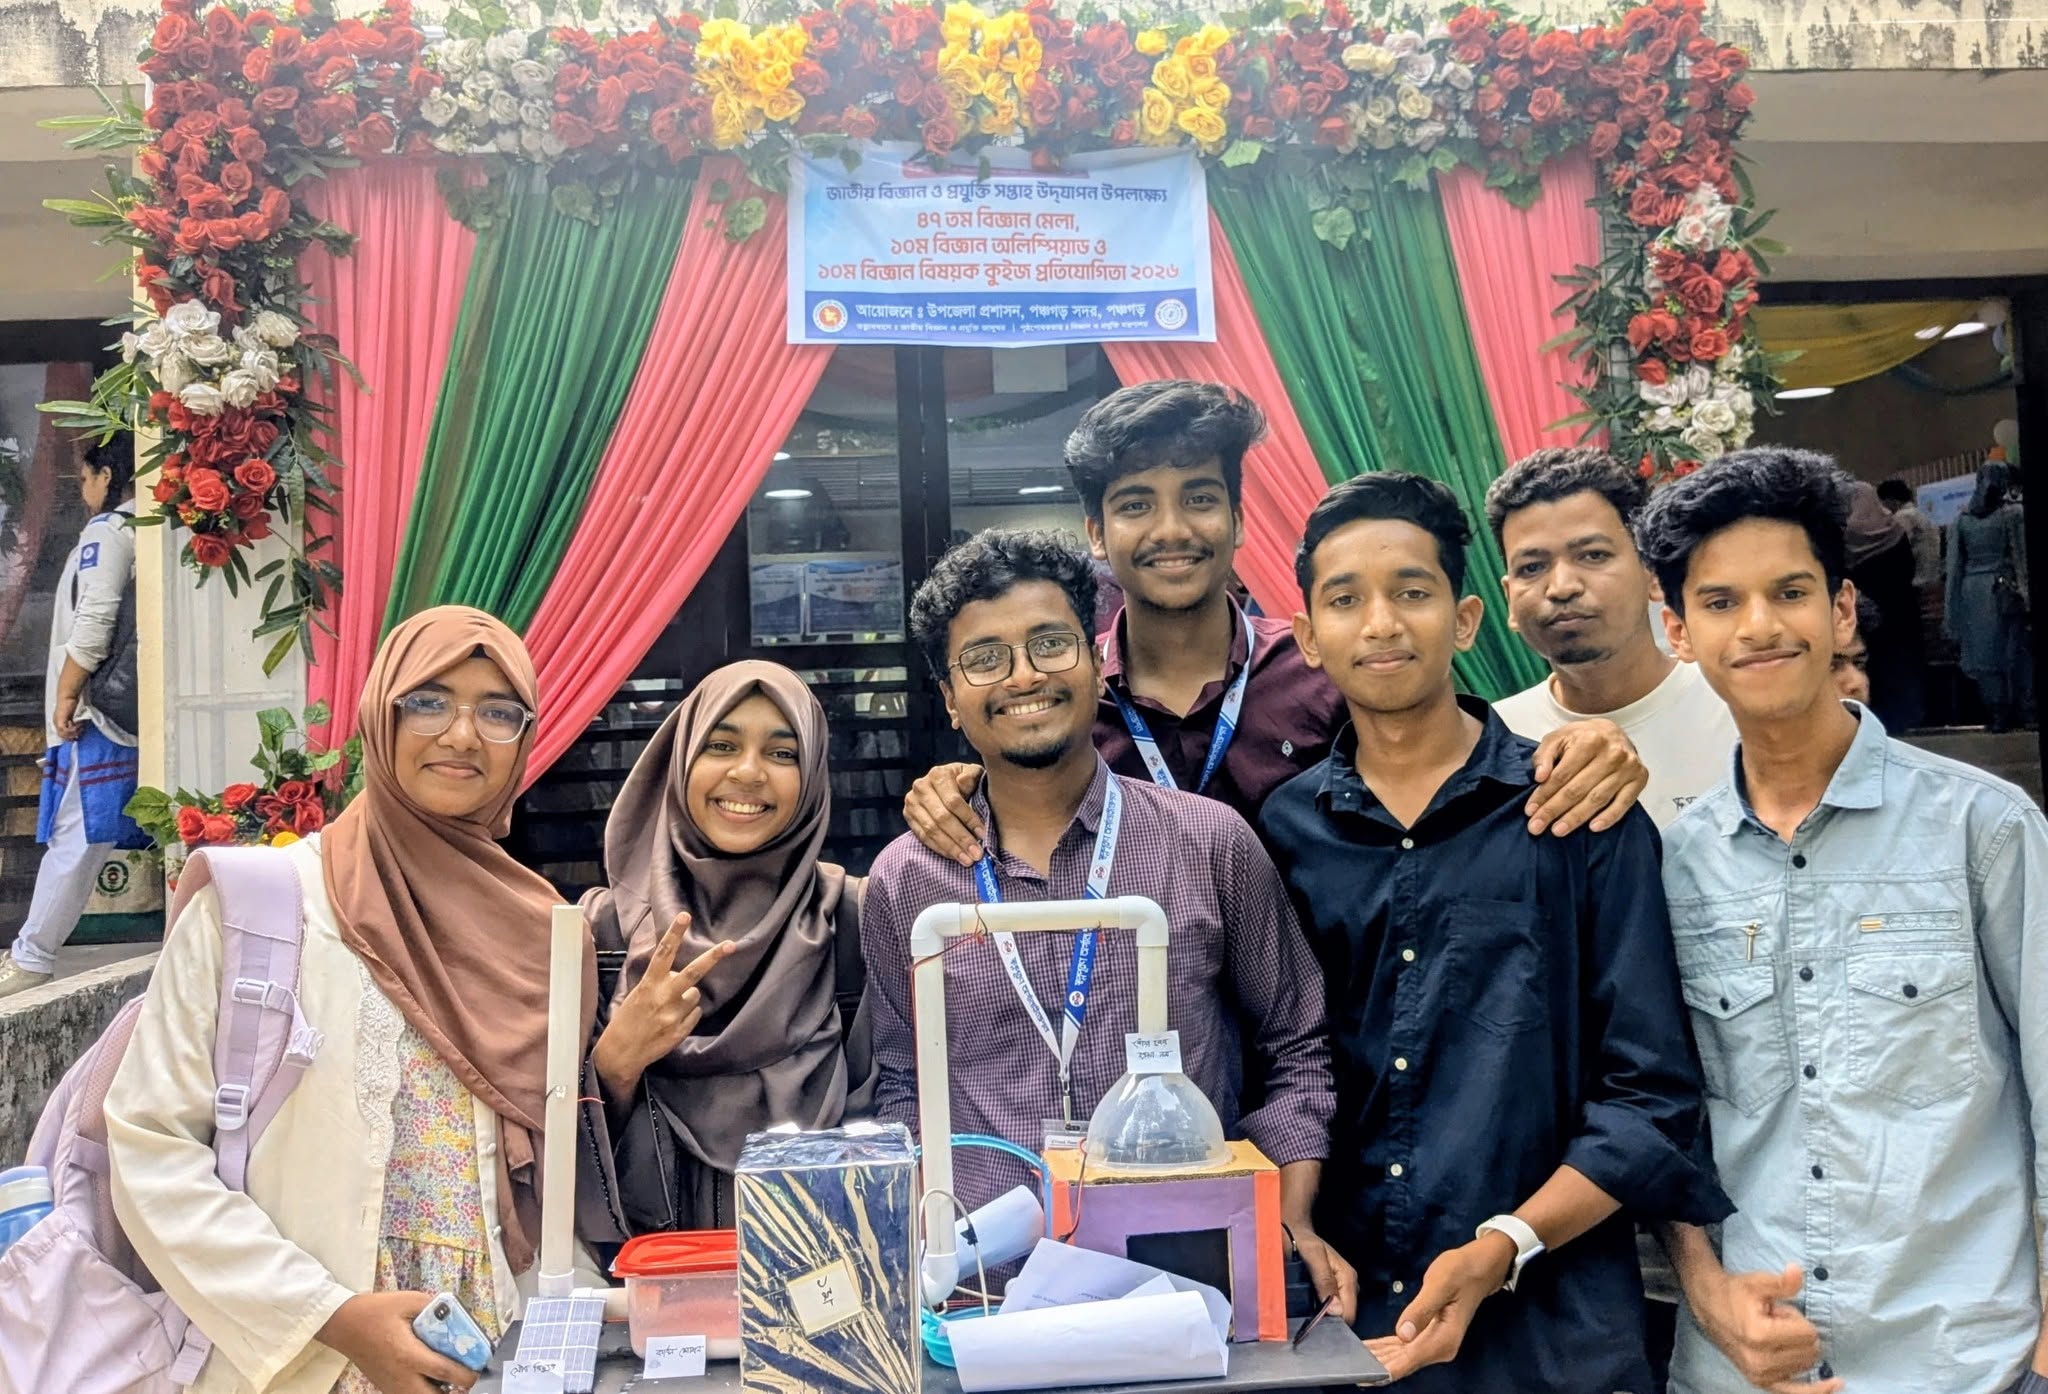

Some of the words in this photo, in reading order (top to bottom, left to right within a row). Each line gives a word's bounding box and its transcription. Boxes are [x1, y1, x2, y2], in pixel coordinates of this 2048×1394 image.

[826, 182, 875, 201] জাতীয়
[878, 181, 927, 199] বিজ্ঞান
[930, 183, 944, 199] ও
[946, 180, 991, 203] প্রযুক্তি
[994, 183, 1033, 200] সপ্তাহ
[917, 211, 941, 229] ৪৭
[944, 211, 973, 228] তম
[976, 205, 1031, 229] বিজ্ঞান
[1035, 212, 1080, 233] মেলা,
[890, 237, 929, 255] ১০ম
[933, 231, 987, 255] বিজ্ঞান
[991, 232, 1090, 257] অলিম্পিয়াড
[1093, 239, 1107, 256] ও
[817, 263, 857, 280] ১০ম
[860, 258, 915, 281] বিজ্ঞান
[919, 258, 980, 282] বিষয়ক
[983, 259, 1031, 287] কুইজ
[1035, 257, 1127, 282] প্রতিযোগিতা
[1131, 263, 1179, 280] ২০২৬
[855, 303, 914, 318] আয়োজনে
[926, 301, 976, 319] উপজেলা
[979, 303, 1025, 320] প্রশাসন,
[1029, 303, 1069, 320] পঞ্চগড়
[1071, 304, 1102, 320] সদর,
[1105, 302, 1146, 318] পঞ্চগড়
